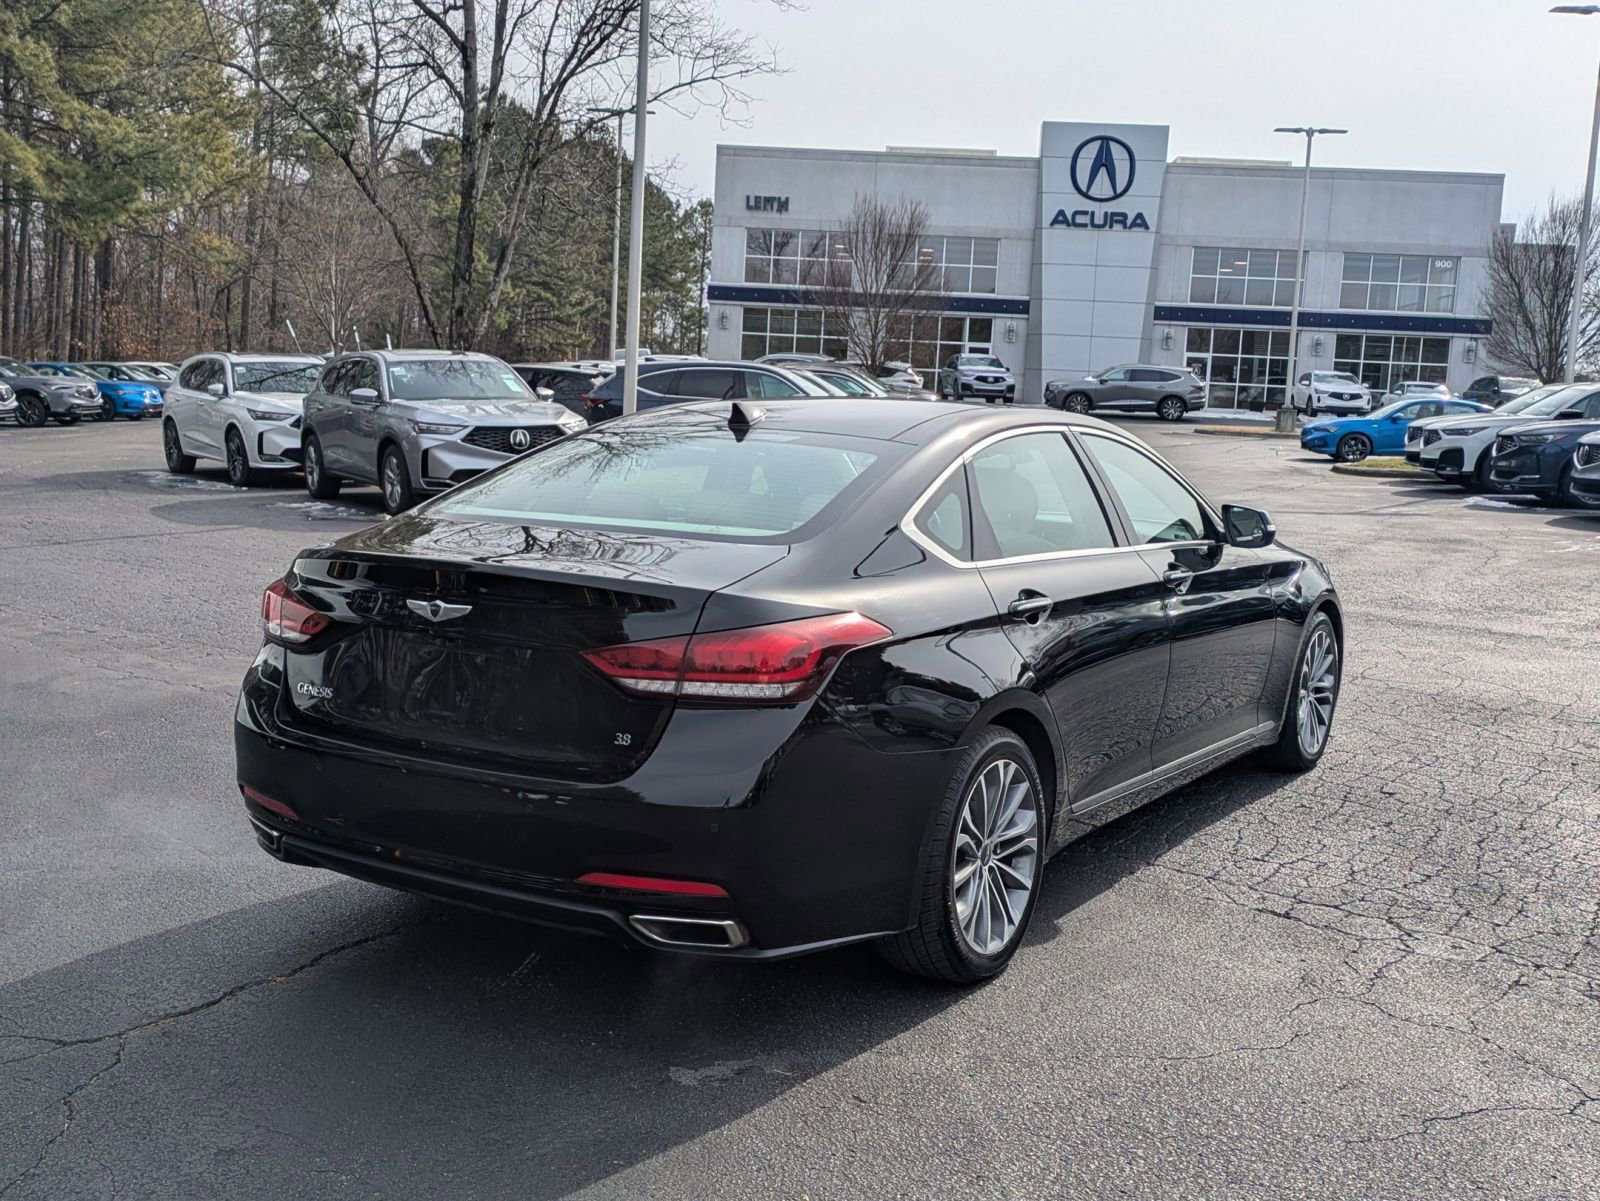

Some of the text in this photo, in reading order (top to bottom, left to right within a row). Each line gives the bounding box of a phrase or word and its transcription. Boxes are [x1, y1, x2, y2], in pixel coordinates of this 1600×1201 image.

[745, 195, 790, 212] LEITH
[1049, 208, 1150, 231] ACURA
[1435, 260, 1452, 268] 900
[297, 681, 334, 699] GENESIS
